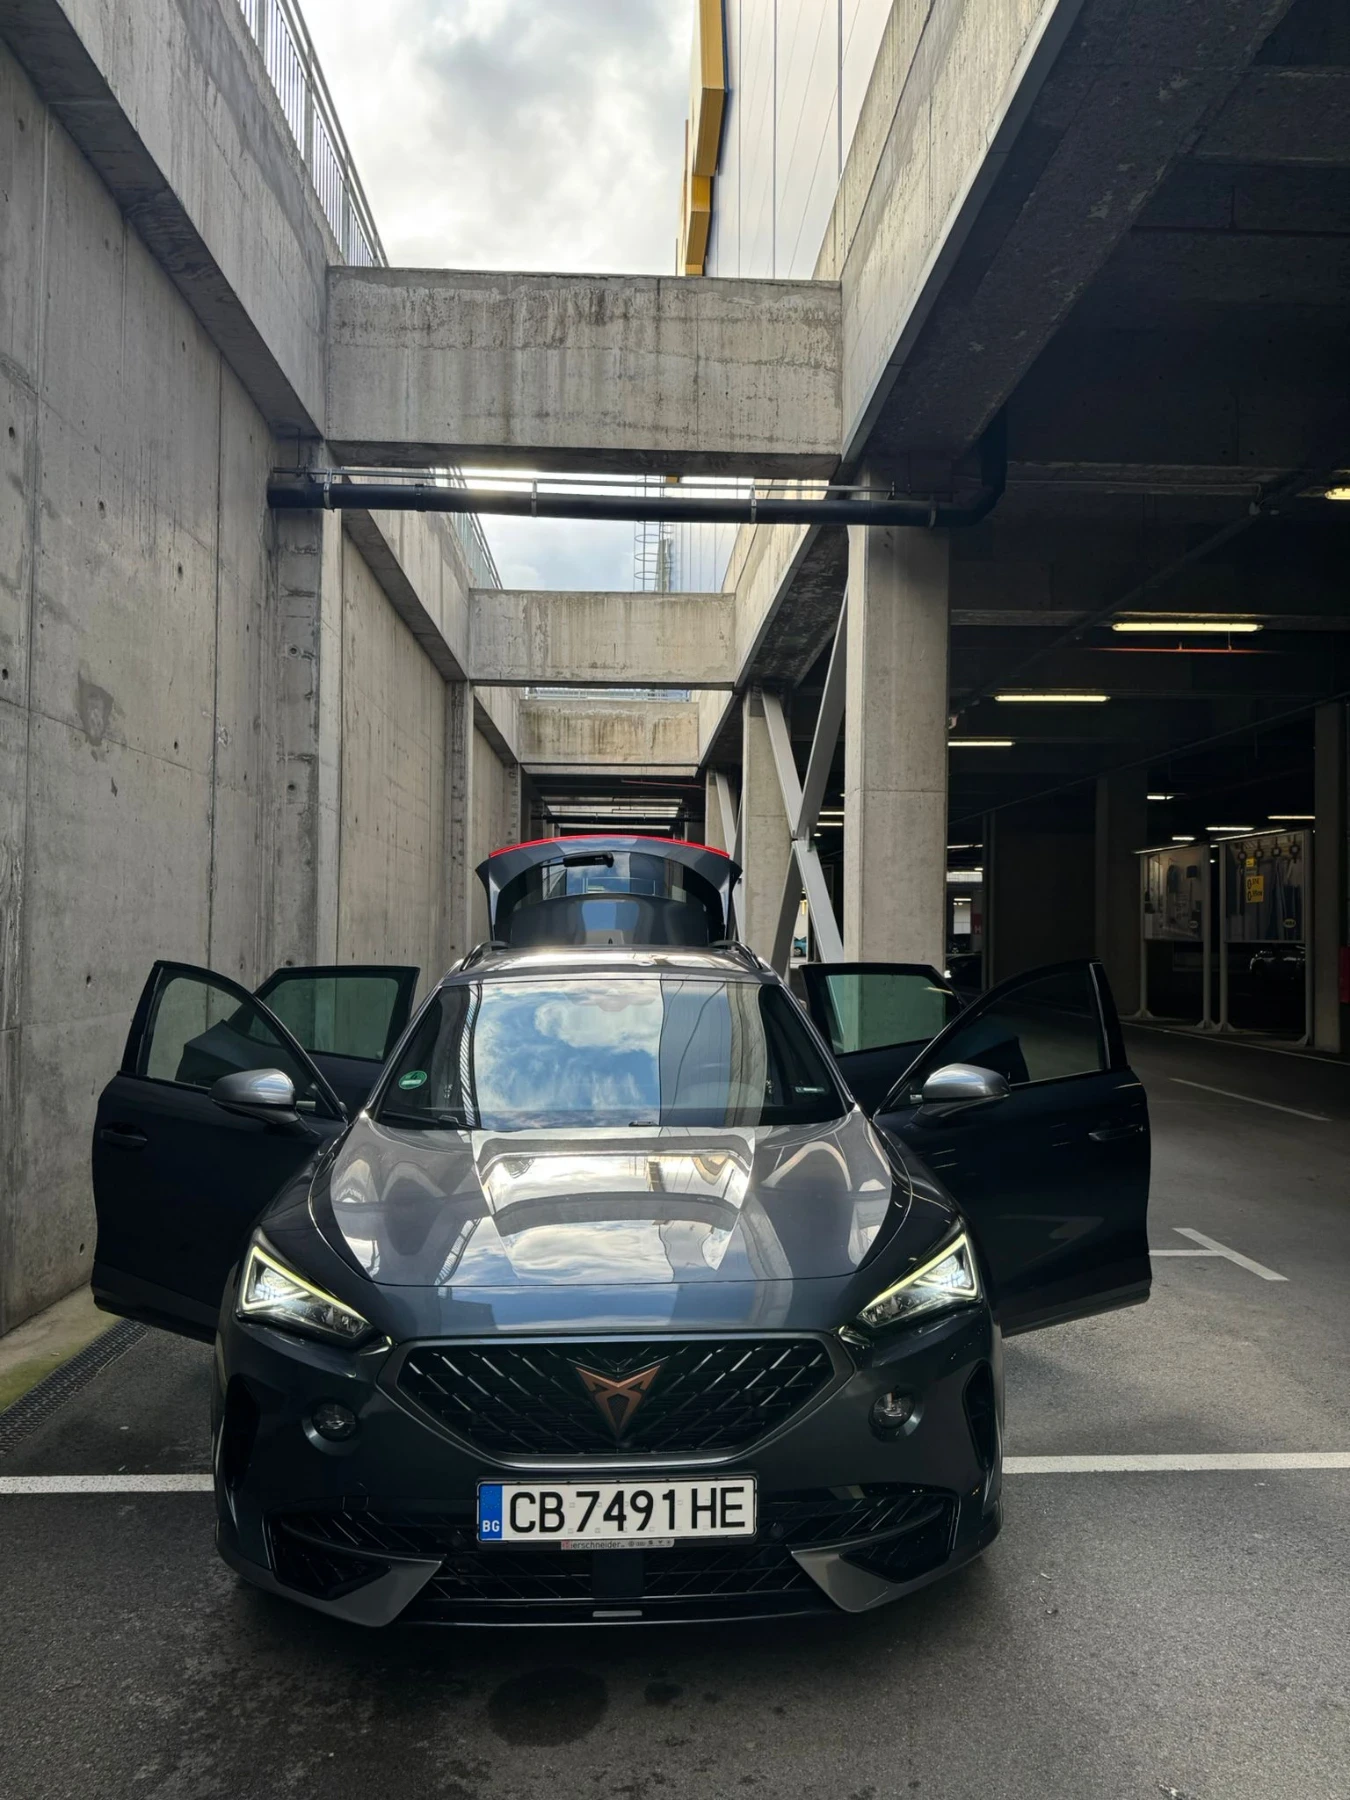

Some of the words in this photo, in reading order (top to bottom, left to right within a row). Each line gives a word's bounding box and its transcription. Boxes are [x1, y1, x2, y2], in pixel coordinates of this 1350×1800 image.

[509, 1491, 565, 1534] CB
[576, 1489, 676, 1532] 7491
[691, 1486, 746, 1529] HE
[482, 1520, 500, 1532] BG
